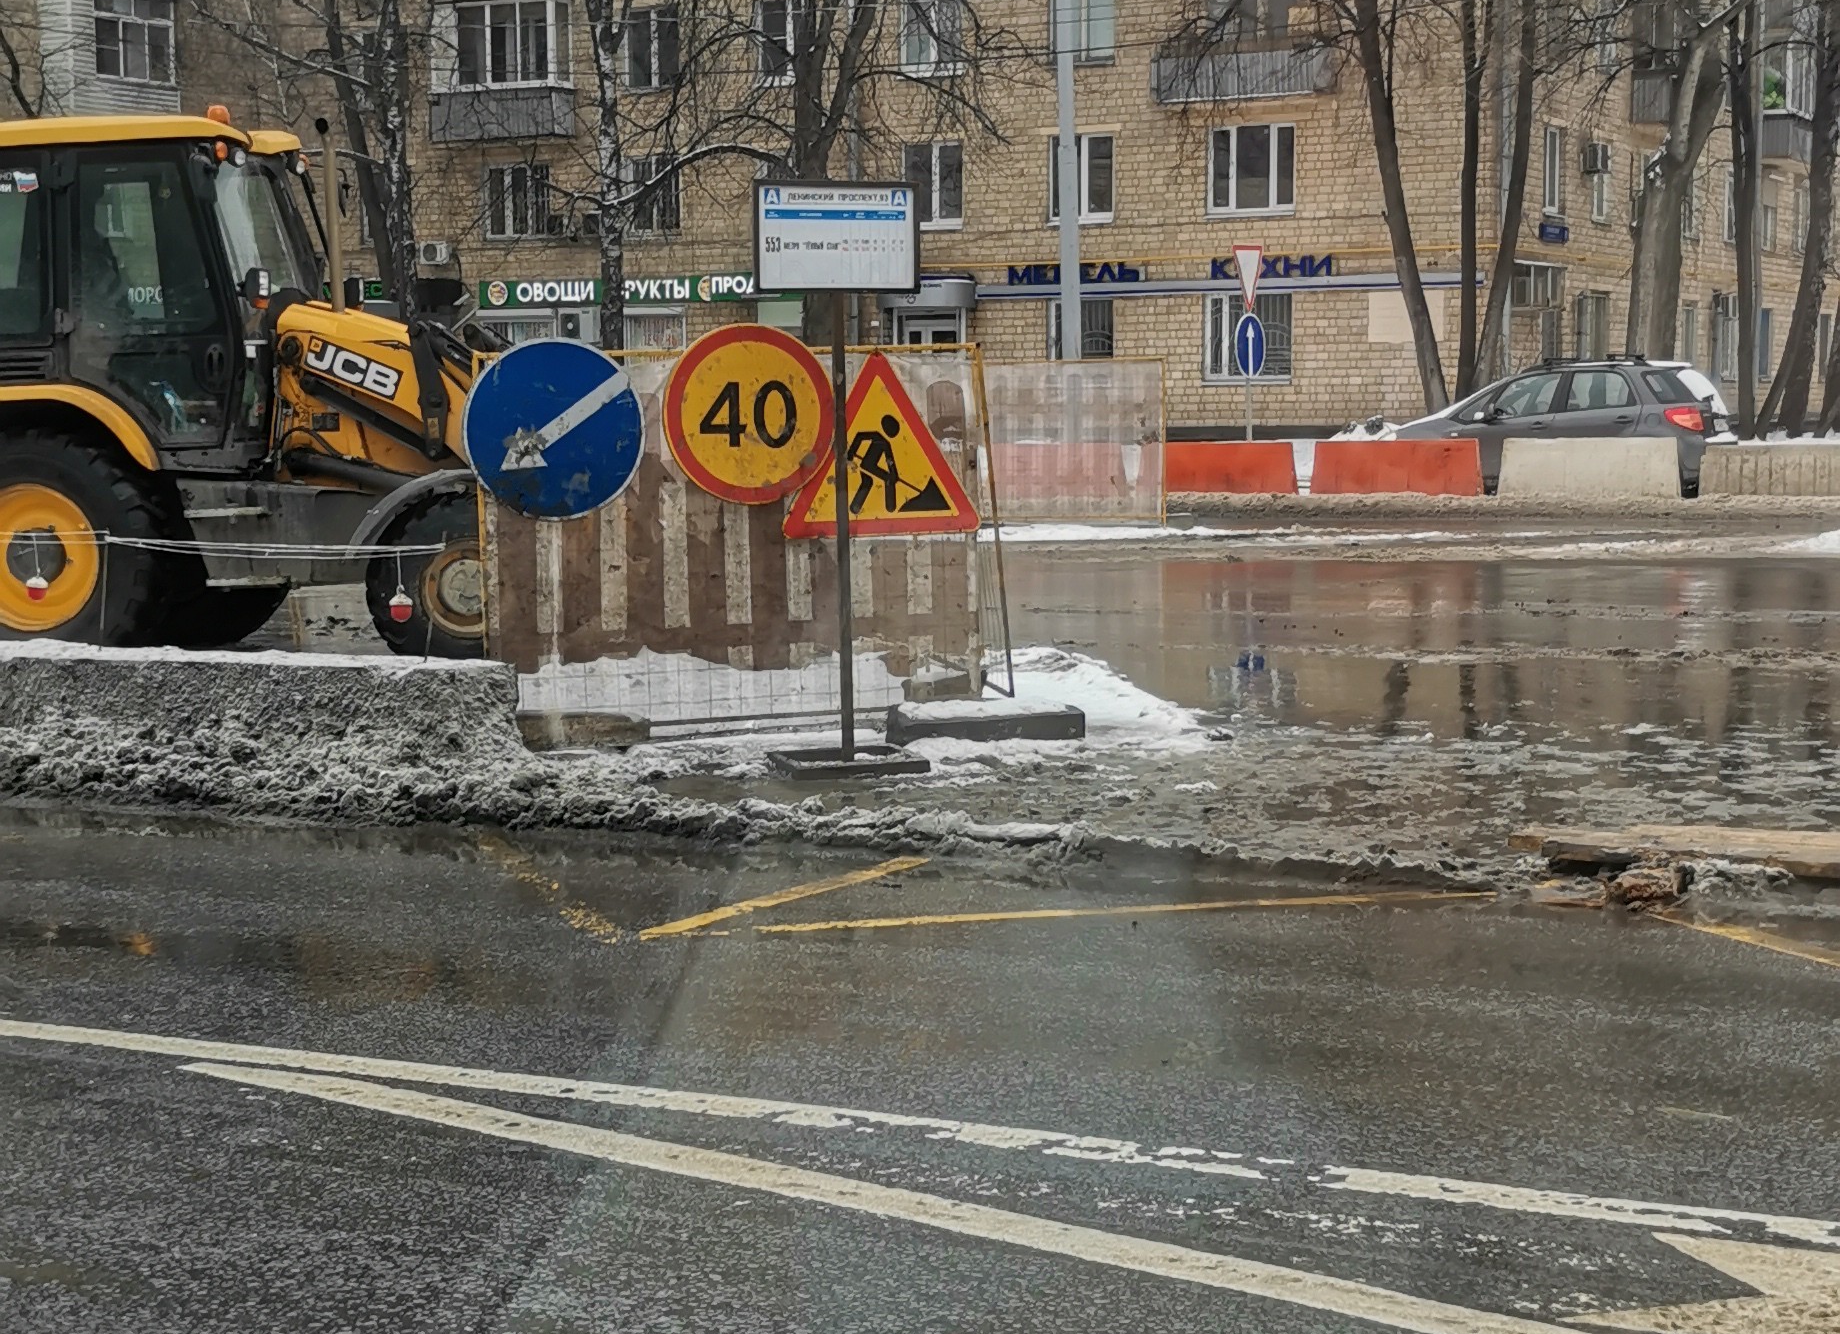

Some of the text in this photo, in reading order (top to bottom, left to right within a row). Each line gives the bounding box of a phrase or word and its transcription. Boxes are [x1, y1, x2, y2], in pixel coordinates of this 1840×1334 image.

[765, 236, 781, 253] 553
[1211, 253, 1333, 280] КХНИ
[516, 281, 595, 303] ОВОЩИ
[621, 278, 691, 300] РУКТЫ
[306, 344, 399, 397] JCB
[699, 380, 797, 449] 40
